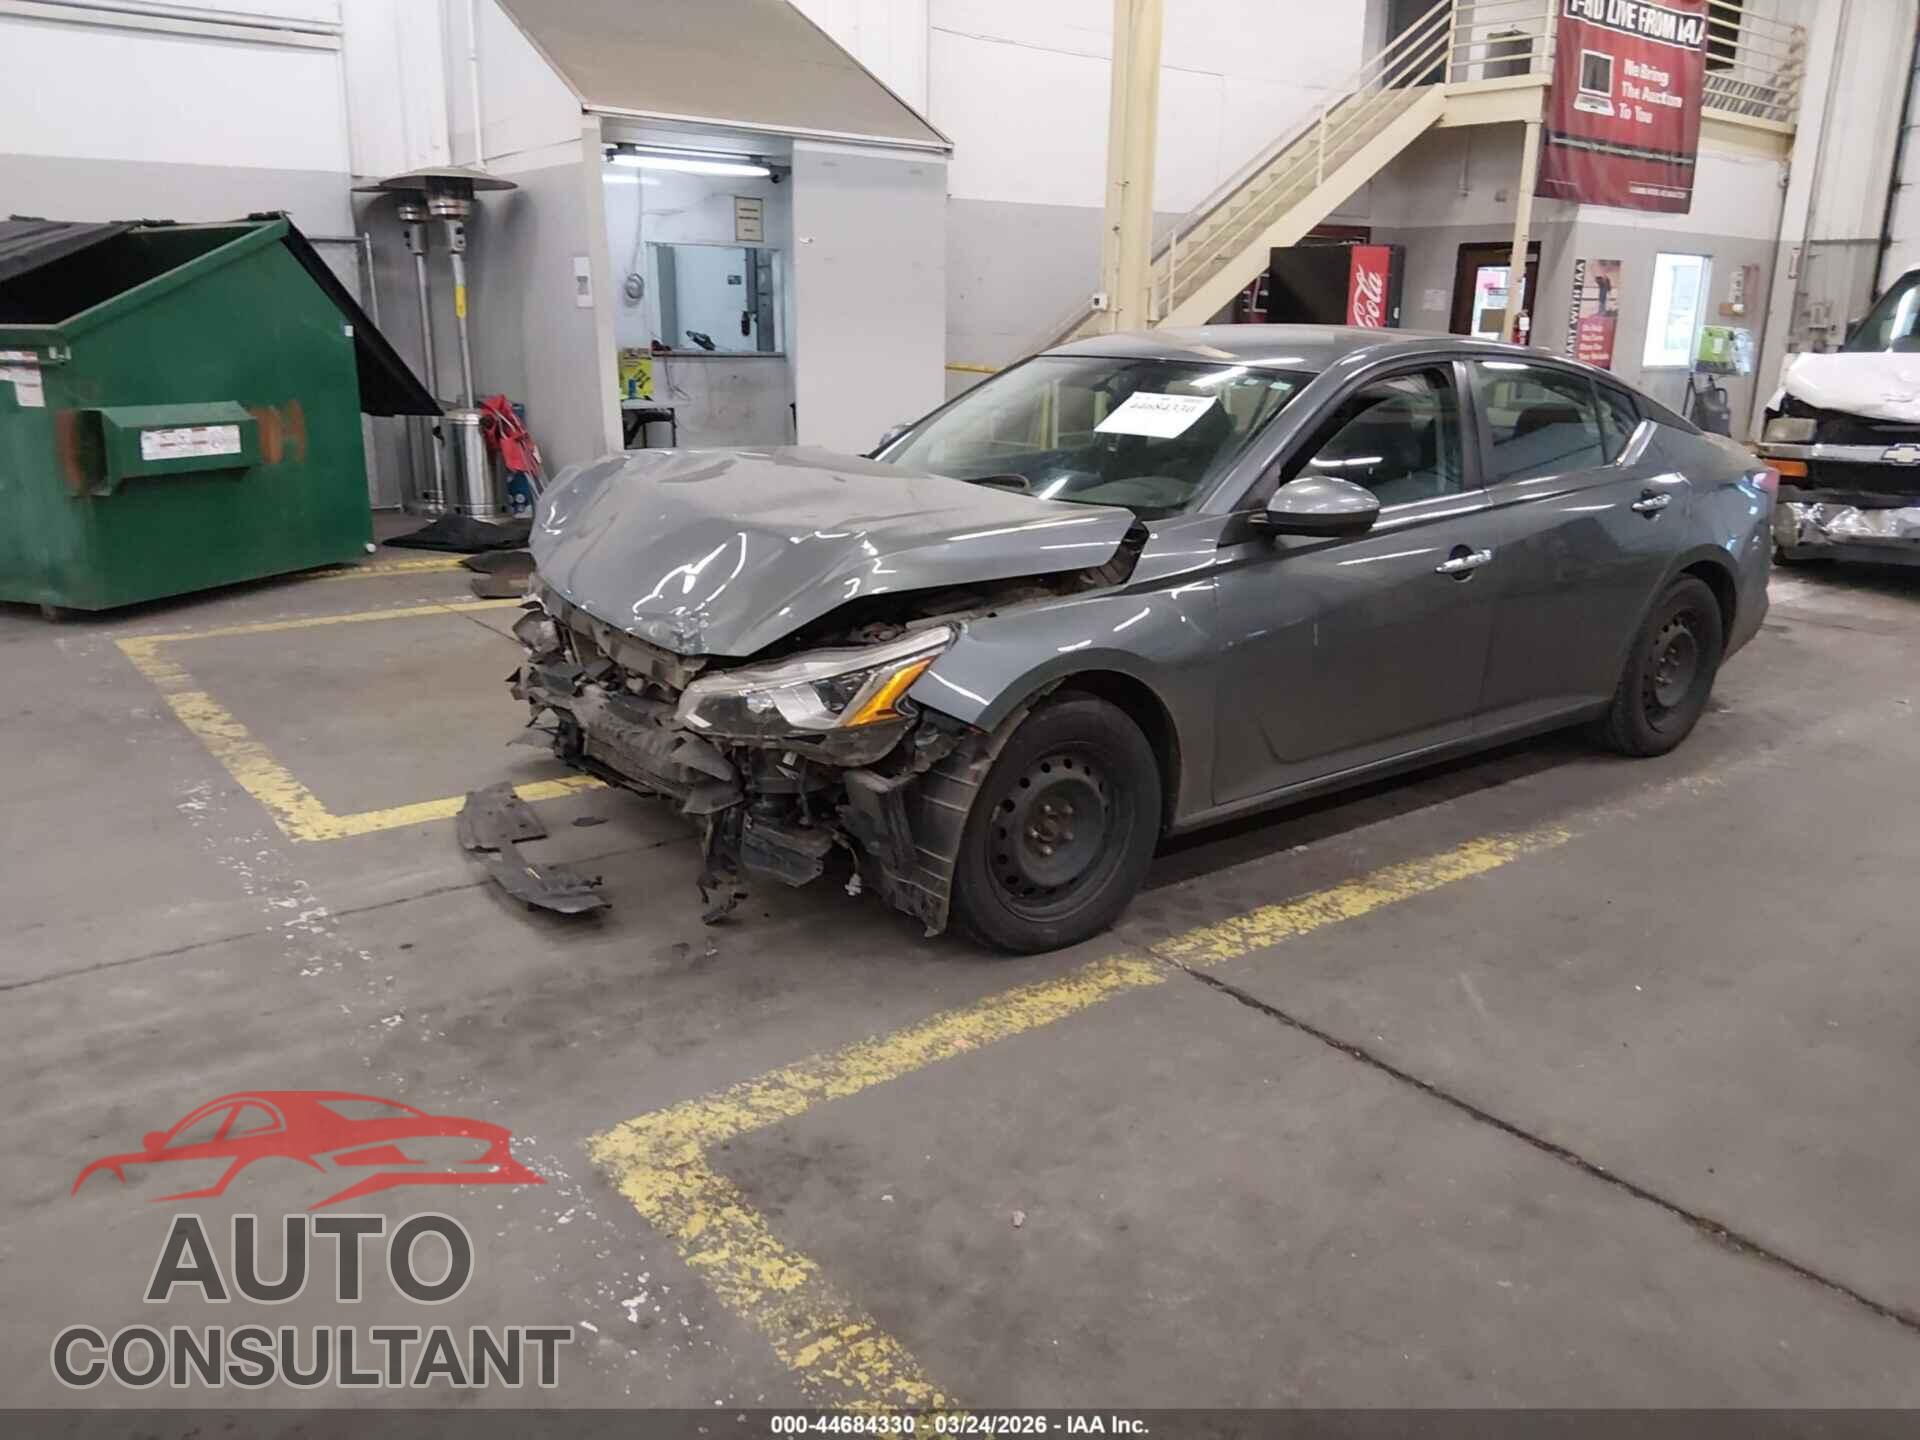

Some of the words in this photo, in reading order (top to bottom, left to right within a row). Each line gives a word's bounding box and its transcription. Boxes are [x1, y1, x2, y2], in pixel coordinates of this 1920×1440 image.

[1606, 0, 1639, 29] LIVE
[1637, 7, 1677, 40] FROM
[1622, 80, 1640, 100] The
[1619, 102, 1632, 120] To
